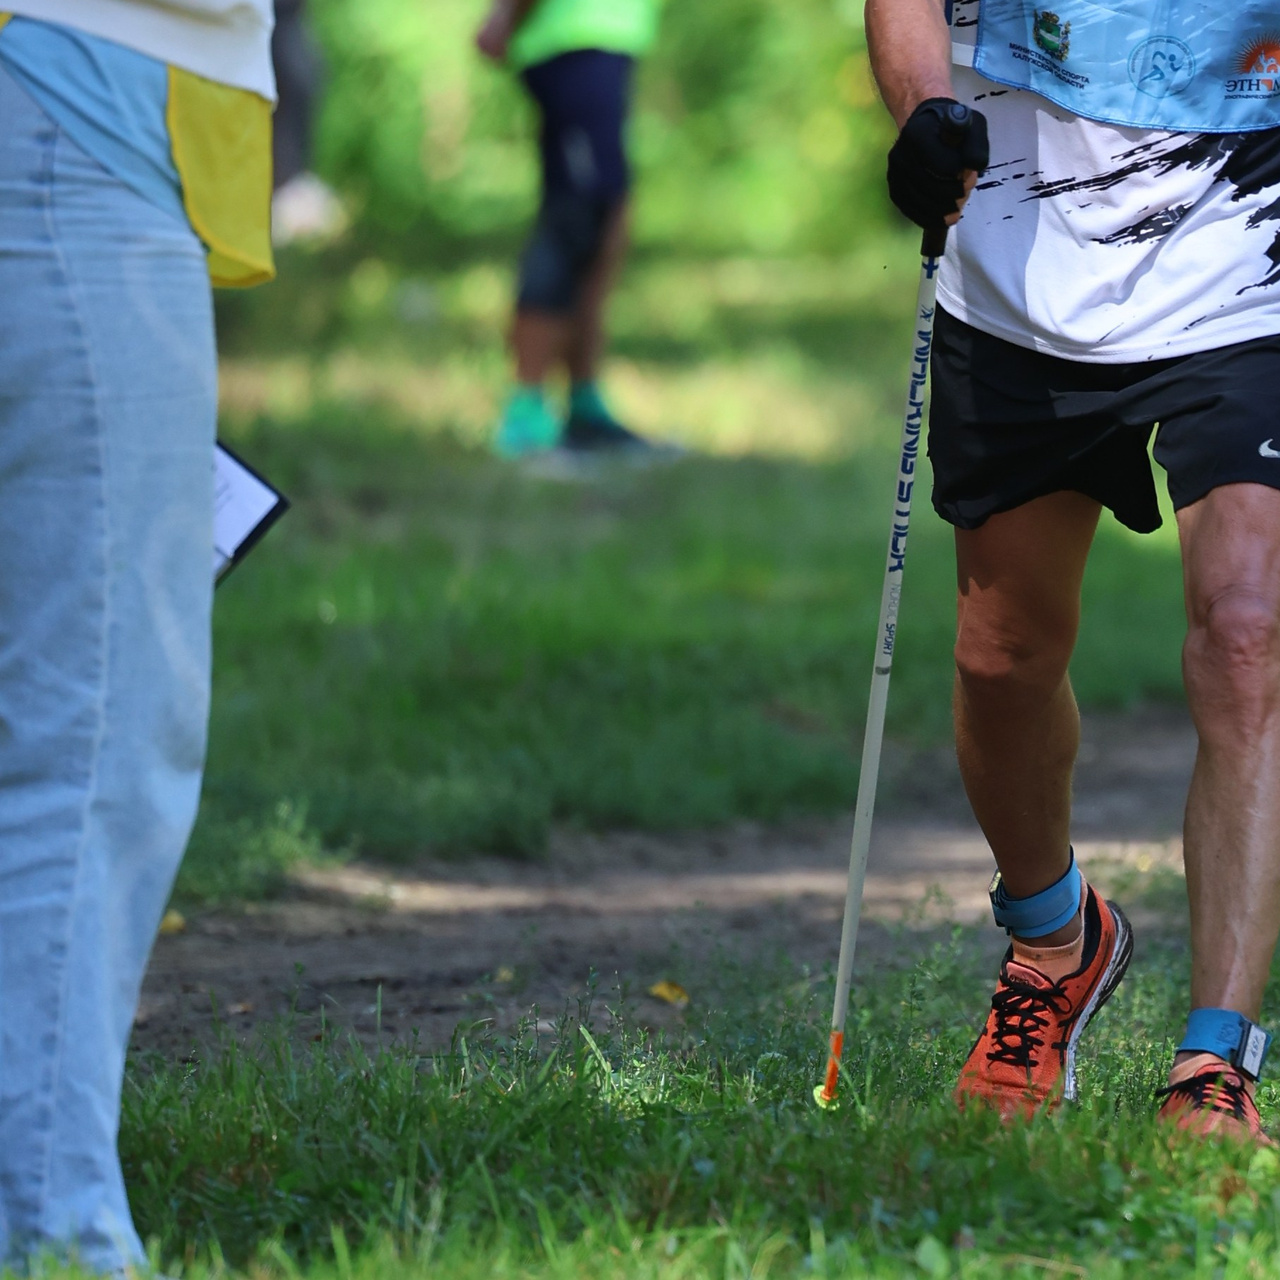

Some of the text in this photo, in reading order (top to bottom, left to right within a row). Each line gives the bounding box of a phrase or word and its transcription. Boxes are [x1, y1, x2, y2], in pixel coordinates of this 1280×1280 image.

[1061, 68, 1090, 84] СПОРТА
[901, 330, 932, 475] WALKING
[882, 623, 896, 656] SPORT
